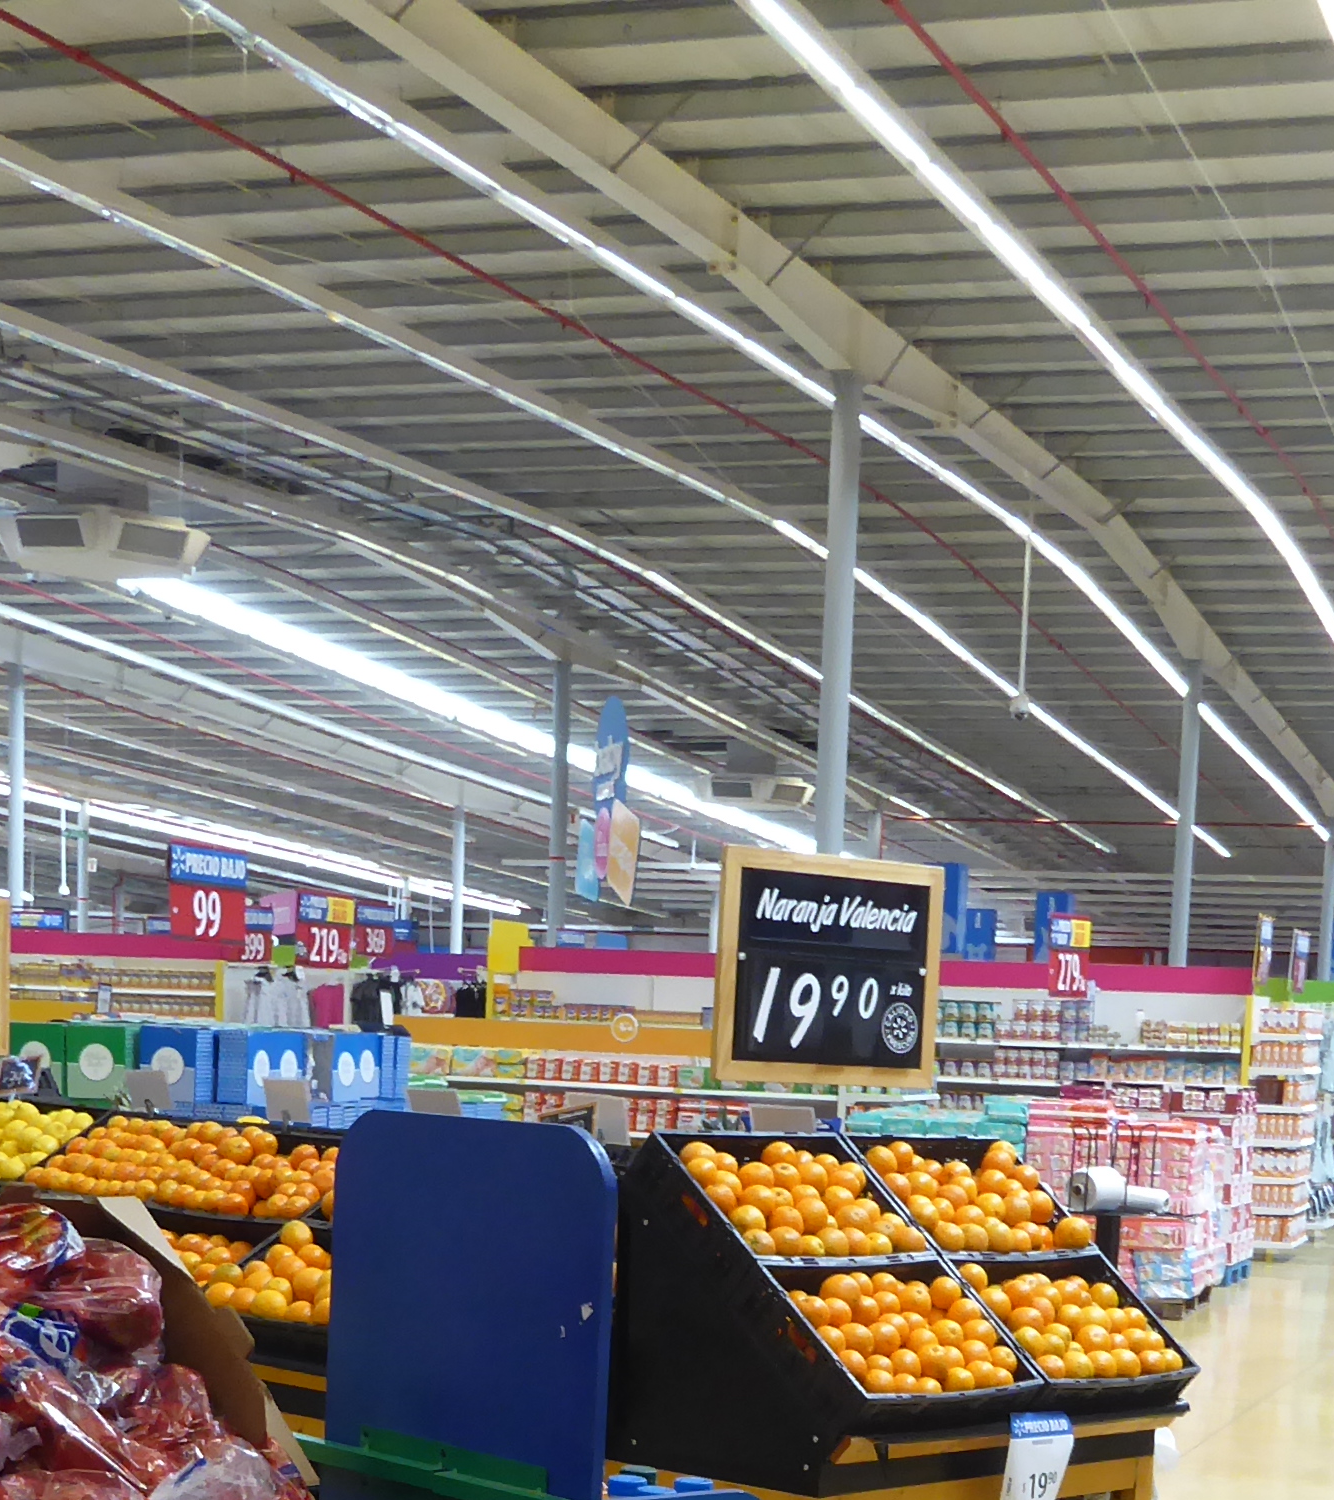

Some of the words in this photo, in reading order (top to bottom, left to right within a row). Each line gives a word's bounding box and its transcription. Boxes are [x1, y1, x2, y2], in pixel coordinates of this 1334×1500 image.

[185, 853, 220, 878] PRECIO
[221, 857, 246, 880] BAJO
[193, 890, 221, 937] 99
[756, 887, 838, 933] Naranja
[839, 895, 917, 933] Valencia
[309, 926, 340, 964] 219
